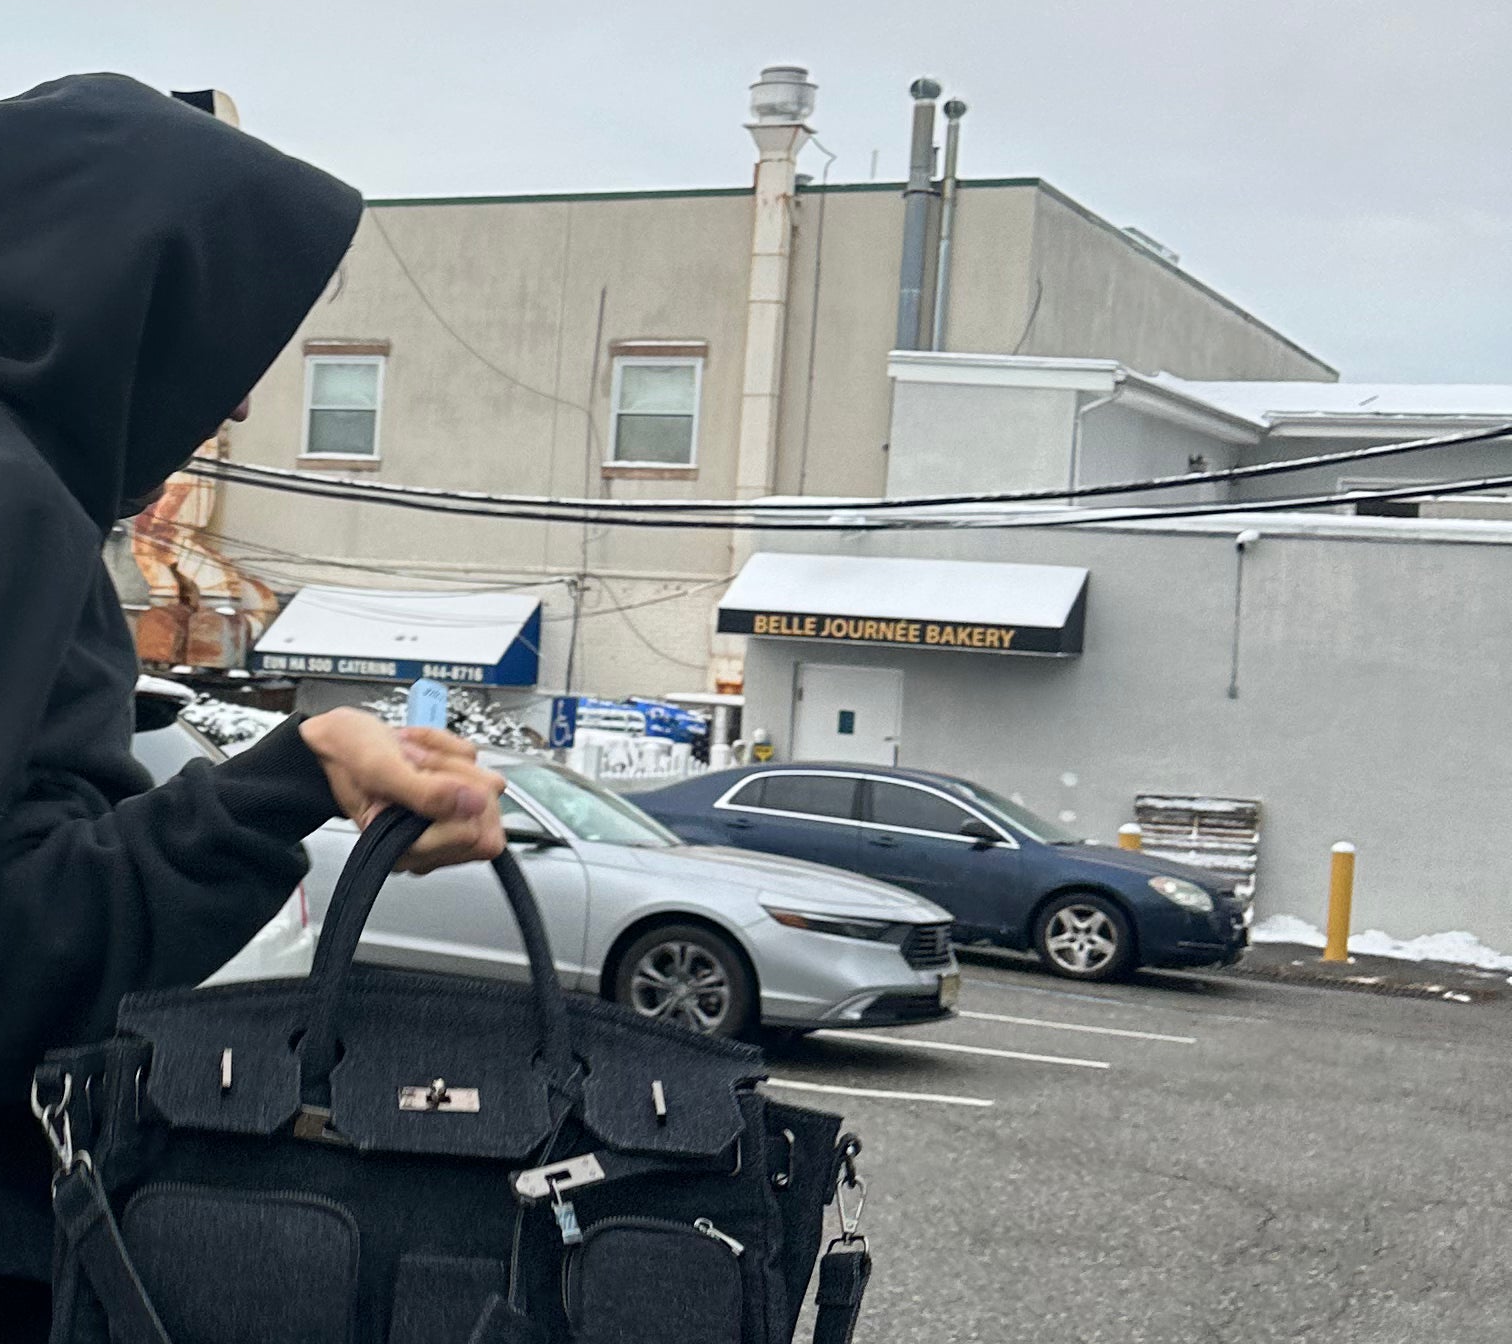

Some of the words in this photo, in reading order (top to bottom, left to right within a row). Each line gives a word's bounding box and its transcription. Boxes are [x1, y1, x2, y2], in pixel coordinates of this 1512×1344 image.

[753, 614, 817, 636] BELLE
[820, 618, 921, 643] JOURNÉE
[925, 625, 1015, 648] BAKERY
[289, 656, 306, 671] HA
[338, 659, 396, 677] CATERING
